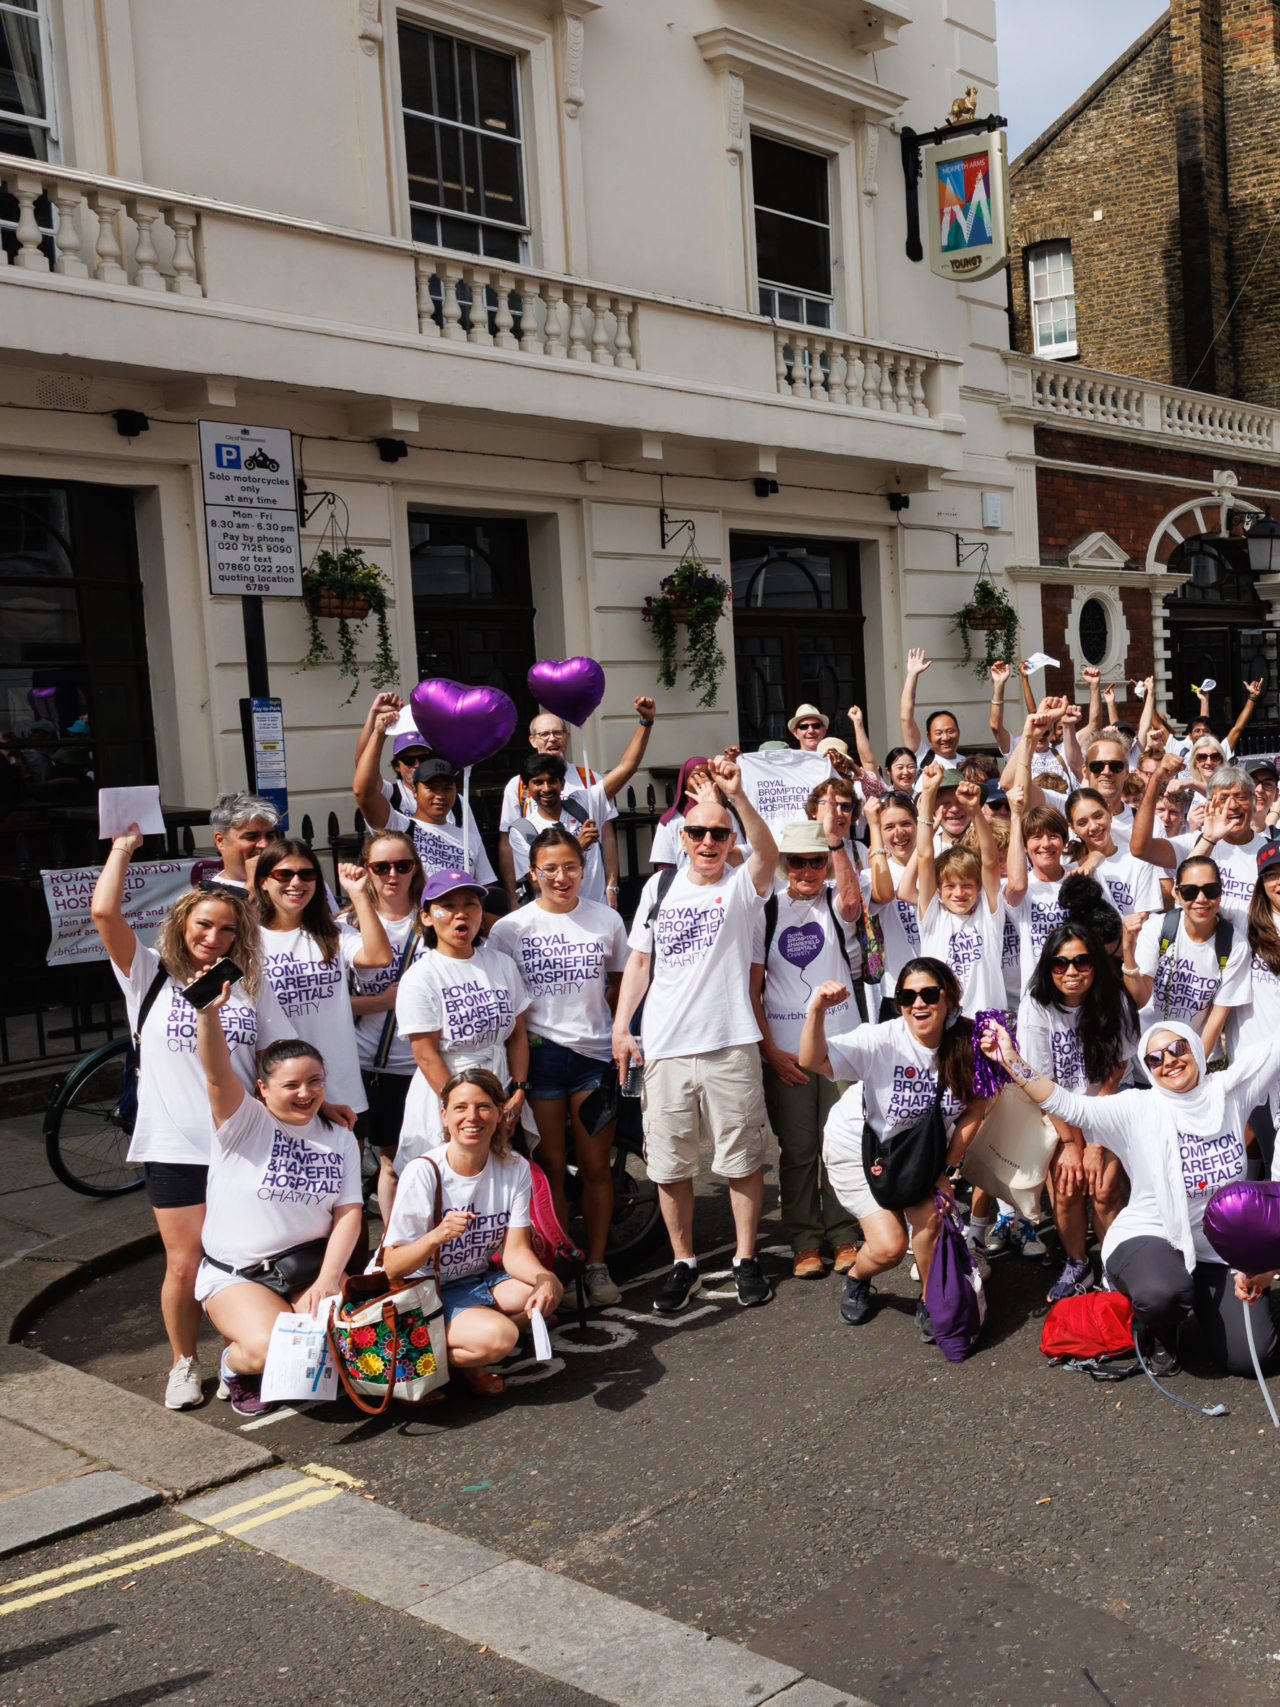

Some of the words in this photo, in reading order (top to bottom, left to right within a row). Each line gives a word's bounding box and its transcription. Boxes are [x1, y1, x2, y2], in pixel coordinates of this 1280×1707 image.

[942, 164, 968, 174] MORPETH
[970, 159, 985, 169] ARMS
[222, 447, 237, 466] P
[209, 472, 230, 481] Solo
[234, 475, 289, 486] motorcycles
[241, 485, 260, 494] only
[257, 496, 277, 505] time
[233, 510, 253, 519] Mon
[260, 512, 272, 520] Fri
[211, 520, 234, 528] 8.30
[257, 523, 279, 531] 6.30
[223, 533, 240, 542] Pay
[243, 534, 253, 543] by
[257, 535, 285, 543] phone
[218, 542, 238, 550] 020
[241, 544, 263, 552] 7125
[266, 545, 292, 554] 9090
[253, 555, 272, 563] text
[218, 562, 250, 571] 07860
[254, 564, 272, 572] 022
[218, 574, 254, 583] quoting
[257, 574, 294, 583] location
[757, 780, 786, 788] ROYAL
[759, 787, 809, 796] BROMPTON
[414, 824, 445, 843] ROAL
[414, 844, 473, 866] &HAREFIED
[50, 871, 98, 885] ROYAL
[53, 886, 63, 897] &
[67, 878, 146, 895] HARLD
[58, 918, 79, 928] Join
[58, 930, 81, 940] heart
[522, 933, 570, 949] ROYAL
[787, 934, 817, 944] BROMPTON
[522, 942, 604, 961] BROMPTON
[660, 933, 717, 956] OSPITAL
[787, 944, 817, 953] HOSPITALS
[262, 952, 300, 967] OYAL
[262, 958, 338, 979] ROMPTON
[270, 970, 342, 992] AREFIELD
[528, 968, 600, 985] HOSPITALS
[277, 985, 334, 1005] SPITALS
[445, 989, 510, 1013] BROMPON
[171, 996, 257, 1018] BRPTON
[167, 1024, 256, 1046] HOTALS
[888, 1104, 965, 1119] HOSPALS
[1178, 1133, 1204, 1144] YAL
[1180, 1130, 1237, 1160] OMPTON
[1182, 1143, 1243, 1173] AREFIELD
[1184, 1162, 1243, 1189] SPITALS
[466, 1210, 511, 1233] MPTON
